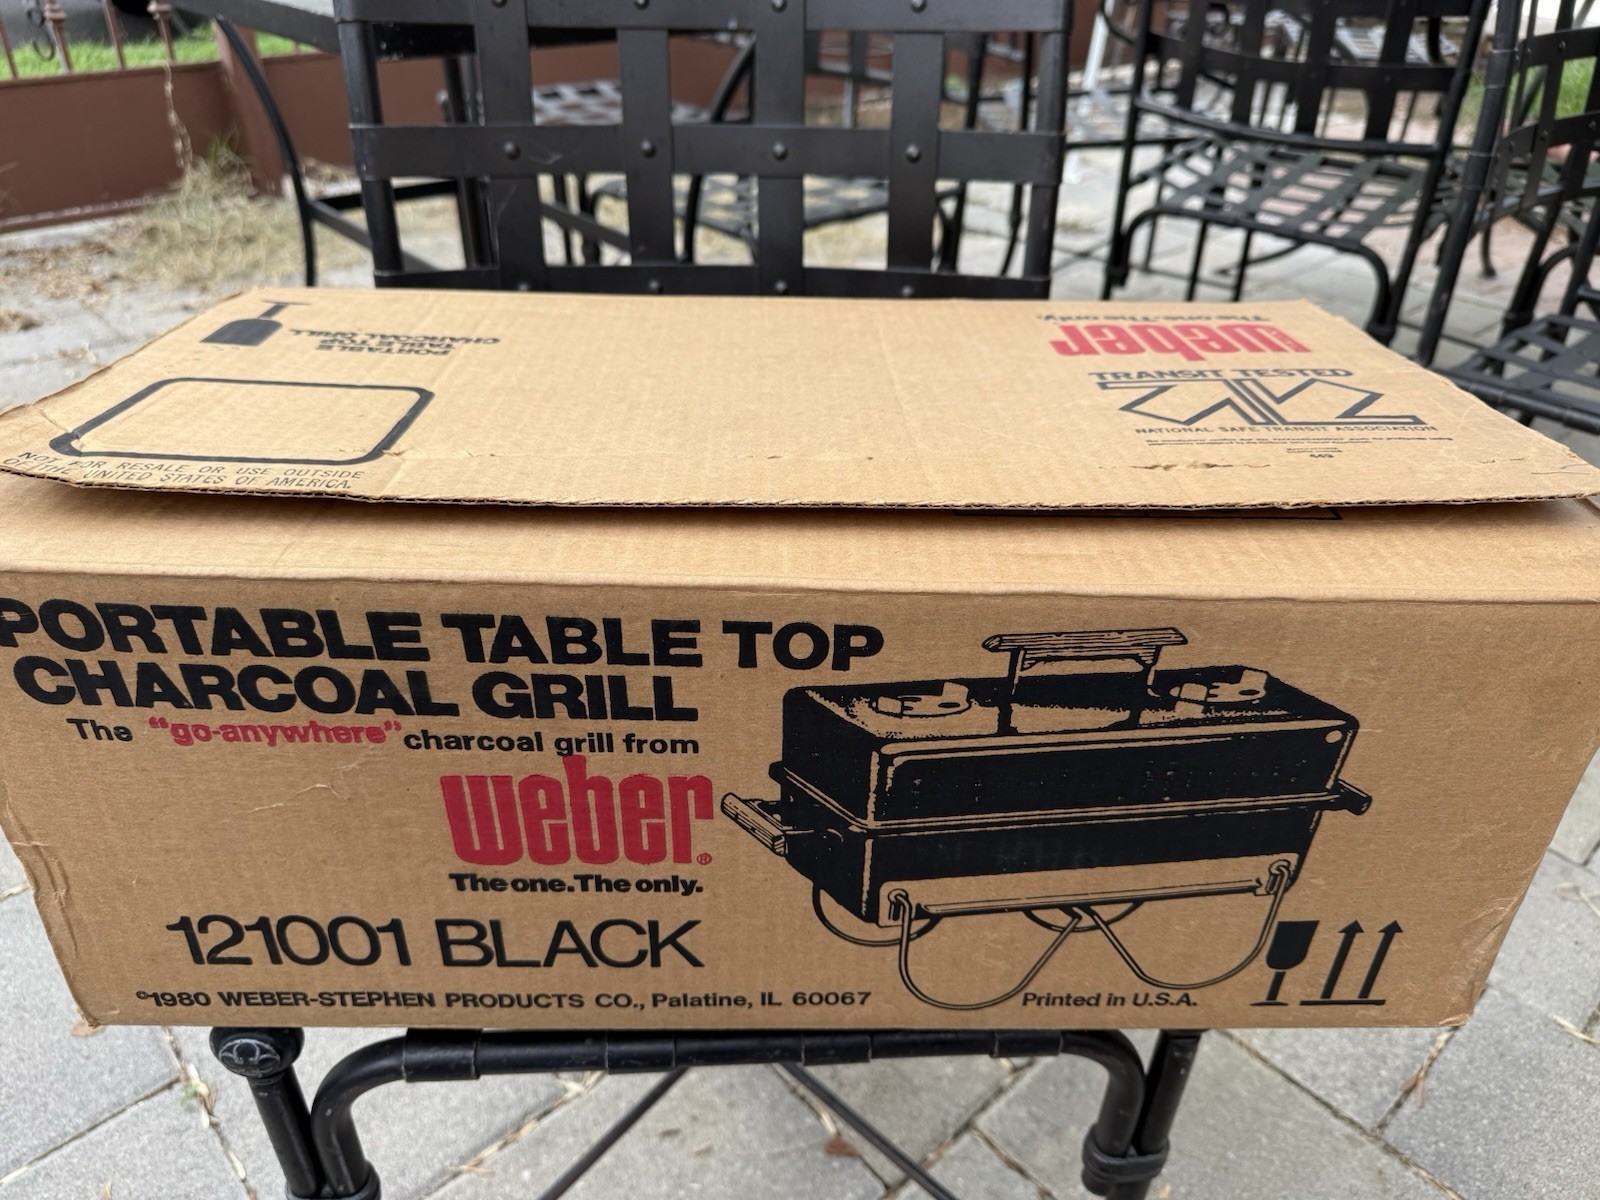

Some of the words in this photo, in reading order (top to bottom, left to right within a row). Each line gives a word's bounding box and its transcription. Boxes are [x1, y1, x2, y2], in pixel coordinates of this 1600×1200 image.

[315, 344, 450, 356] PORTABLE
[365, 333, 501, 345] CHARCOAL
[1049, 323, 1312, 361] weber
[1088, 369, 1222, 381] TRANSIT
[1231, 368, 1354, 378] TESTED
[1135, 425, 1215, 434] NATIONAL
[1218, 425, 1259, 433] SAFE
[1262, 424, 1330, 432] TRANSIT
[1334, 424, 1439, 433] ASSOCIATION
[3, 458, 34, 467] OF
[38, 463, 75, 475] THE
[83, 469, 153, 480] UNITED
[160, 473, 228, 484] STATES
[234, 476, 263, 485] OF
[265, 477, 353, 489] AMERICA.
[18, 452, 61, 463] NOT
[68, 460, 107, 469] FOR
[116, 462, 191, 473] RESALE
[198, 465, 226, 474] OR
[235, 467, 273, 476] USE
[283, 469, 365, 479] OUTSIDE
[0, 597, 431, 662] PORTABLE
[441, 613, 703, 667] TABLE
[722, 620, 885, 671] TOP
[13, 655, 460, 717] CHARCOAL
[472, 671, 699, 722] GRILL
[66, 718, 133, 742] The
[404, 730, 544, 753] charcoal
[554, 732, 614, 758] grill
[622, 733, 700, 755] from
[440, 754, 714, 866] weber
[449, 873, 508, 893] The
[510, 878, 575, 893] one.
[574, 874, 632, 893] The
[635, 875, 704, 897] only.
[166, 915, 412, 967] 121001
[434, 918, 705, 969] BLACK
[217, 991, 437, 1009] WEBER-STEPHEN
[445, 993, 586, 1009] PRODUCTS
[595, 993, 646, 1010] CO.,
[651, 992, 753, 1009] Palatine,
[760, 992, 783, 1006] IL
[792, 991, 872, 1006] 60067
[1022, 992, 1102, 1006] Printed
[1105, 993, 1127, 1006] in
[1131, 992, 1198, 1007] U.S.A.
